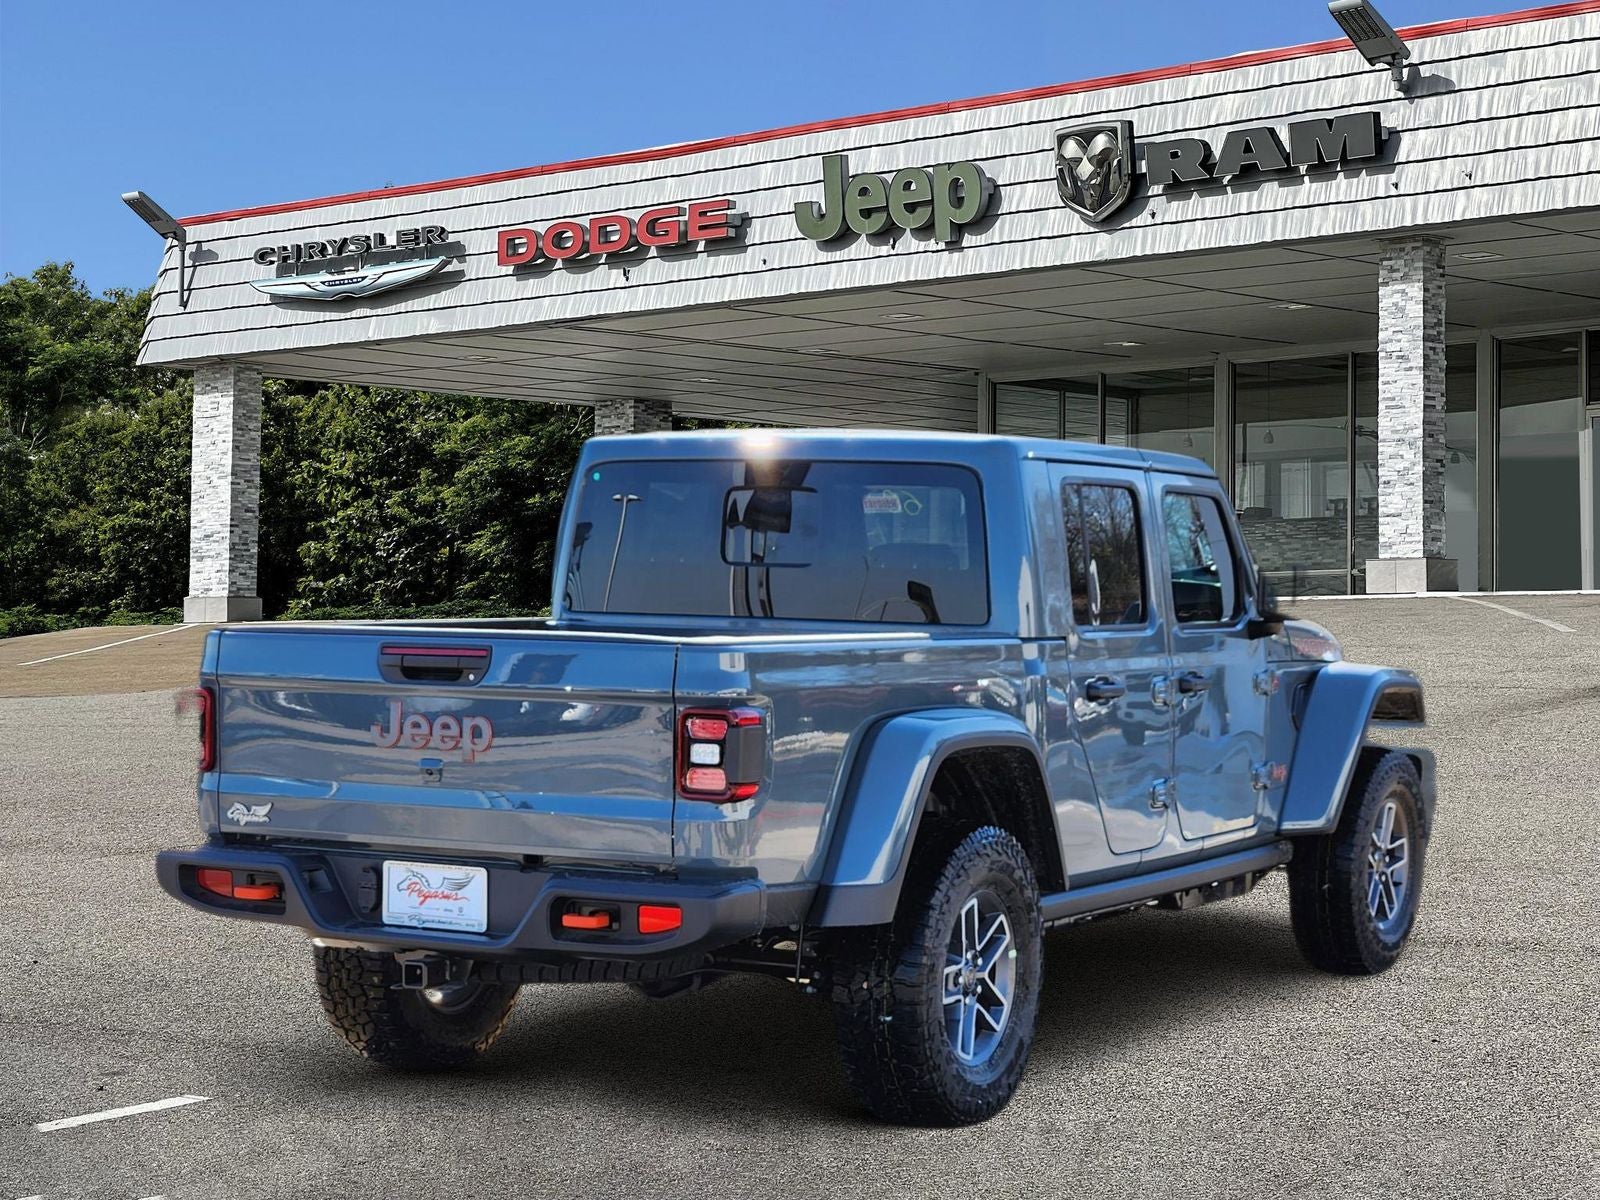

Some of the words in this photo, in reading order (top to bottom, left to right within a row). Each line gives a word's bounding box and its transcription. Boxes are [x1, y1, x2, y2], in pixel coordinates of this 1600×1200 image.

[1146, 110, 1382, 187] RAM
[794, 154, 990, 243] Jeep
[253, 225, 448, 266] CHRYSLER
[497, 198, 736, 266] DODGE
[324, 277, 363, 287] CHRYSLER
[370, 699, 494, 764] Jeep
[406, 881, 471, 907] Pegasus
